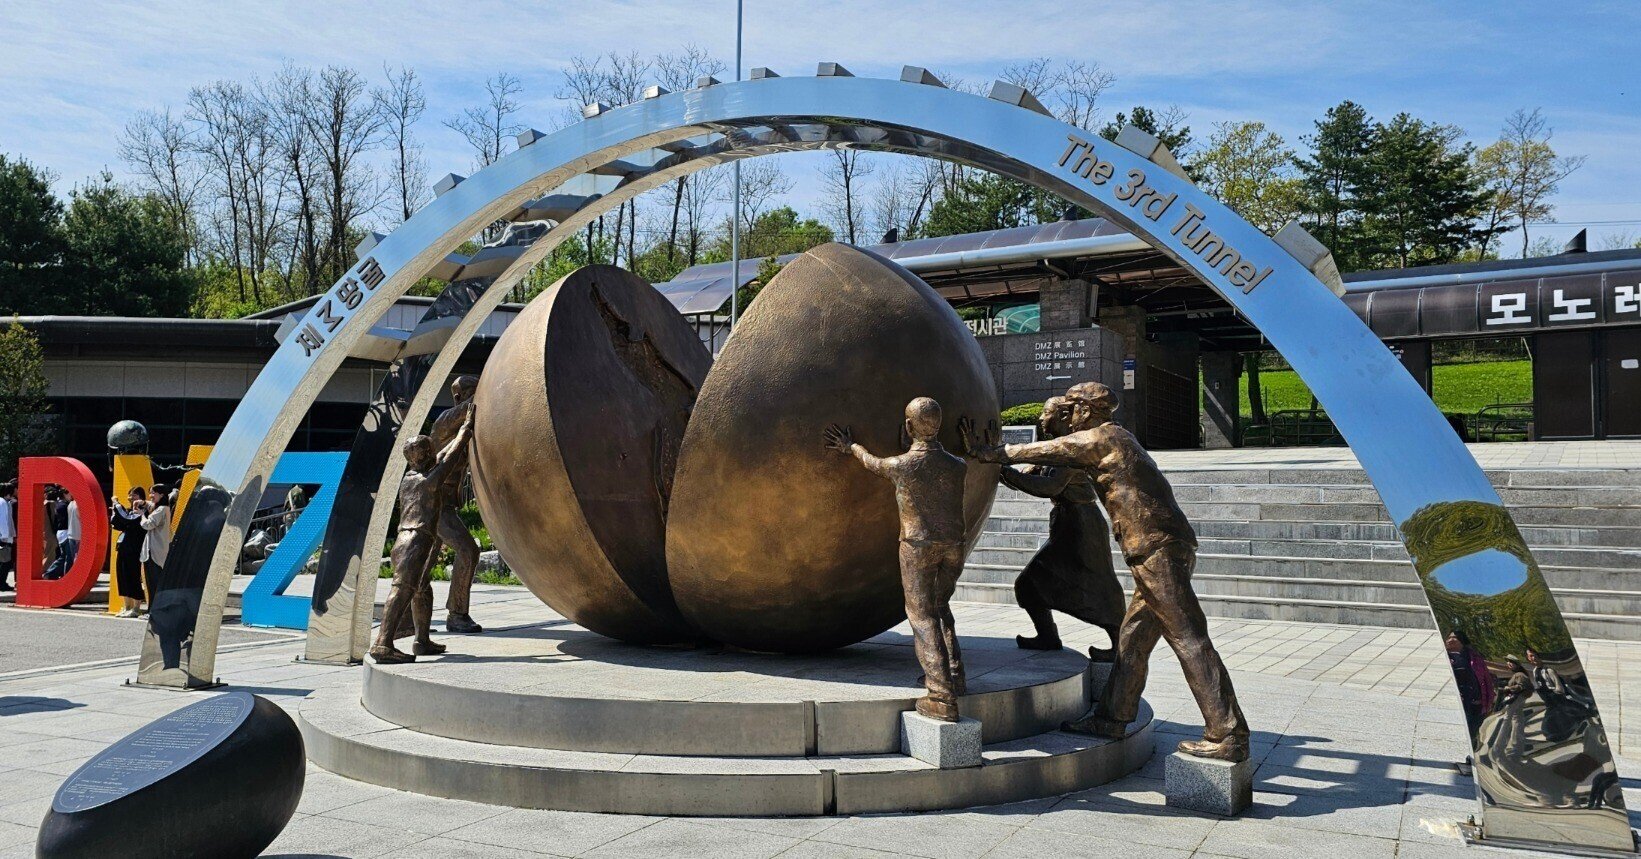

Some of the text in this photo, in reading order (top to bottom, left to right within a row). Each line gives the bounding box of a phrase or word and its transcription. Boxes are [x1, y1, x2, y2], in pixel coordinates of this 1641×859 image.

[1058, 134, 1274, 295] The 3rd Tunnel
[1035, 342, 1052, 350] DMZ
[1035, 351, 1085, 360] DMZ Pavilion
[1035, 363, 1052, 371] DMZ
